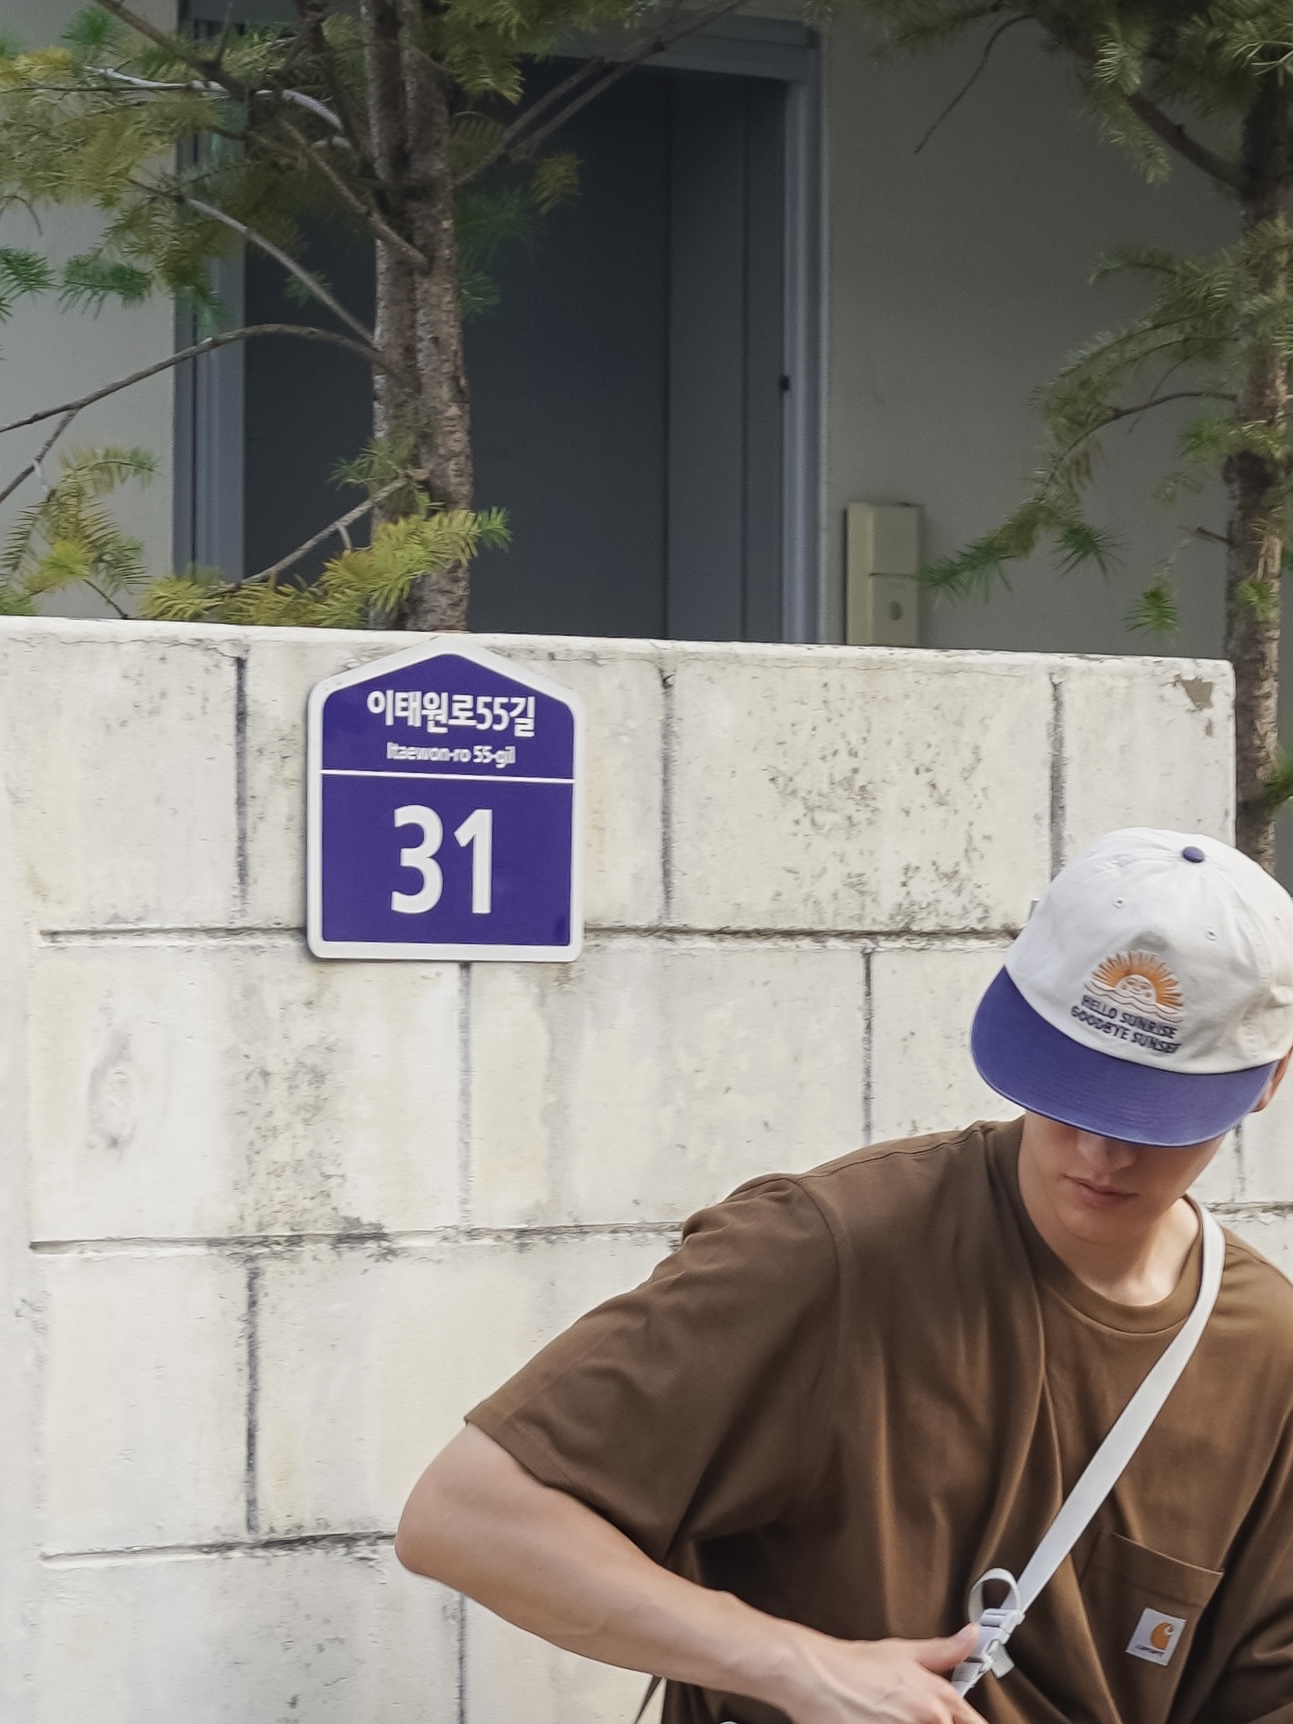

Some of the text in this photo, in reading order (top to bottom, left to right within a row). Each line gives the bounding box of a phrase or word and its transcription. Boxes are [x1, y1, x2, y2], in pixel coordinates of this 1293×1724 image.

[366, 689, 536, 738] 이태원로55길
[386, 741, 516, 769] Itaewon-ro 55-gil
[391, 804, 494, 915] 31
[1081, 994, 1118, 1019] HELLO
